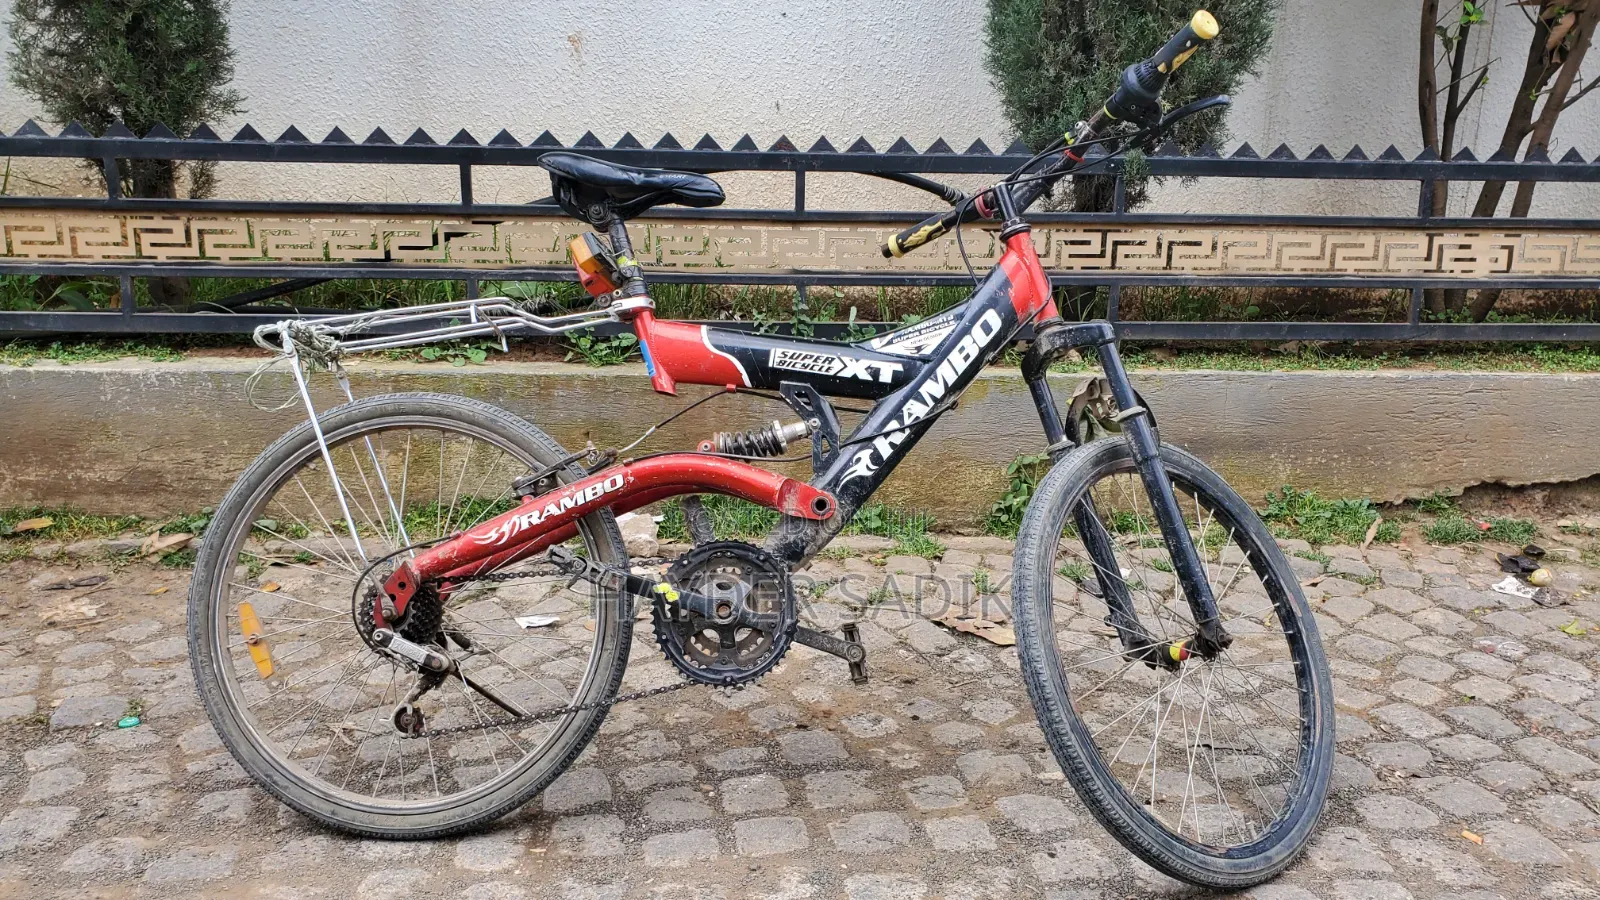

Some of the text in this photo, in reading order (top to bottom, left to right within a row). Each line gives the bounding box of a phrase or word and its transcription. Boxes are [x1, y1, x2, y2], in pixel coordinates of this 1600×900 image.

[892, 331, 920, 344] SUPER
[920, 320, 956, 335] BICYCLE
[776, 360, 834, 373] BICYCLE
[777, 350, 836, 365] SUPER
[839, 356, 904, 383] XT
[872, 308, 1002, 462] RAMBO
[519, 473, 624, 532] RAMBO
